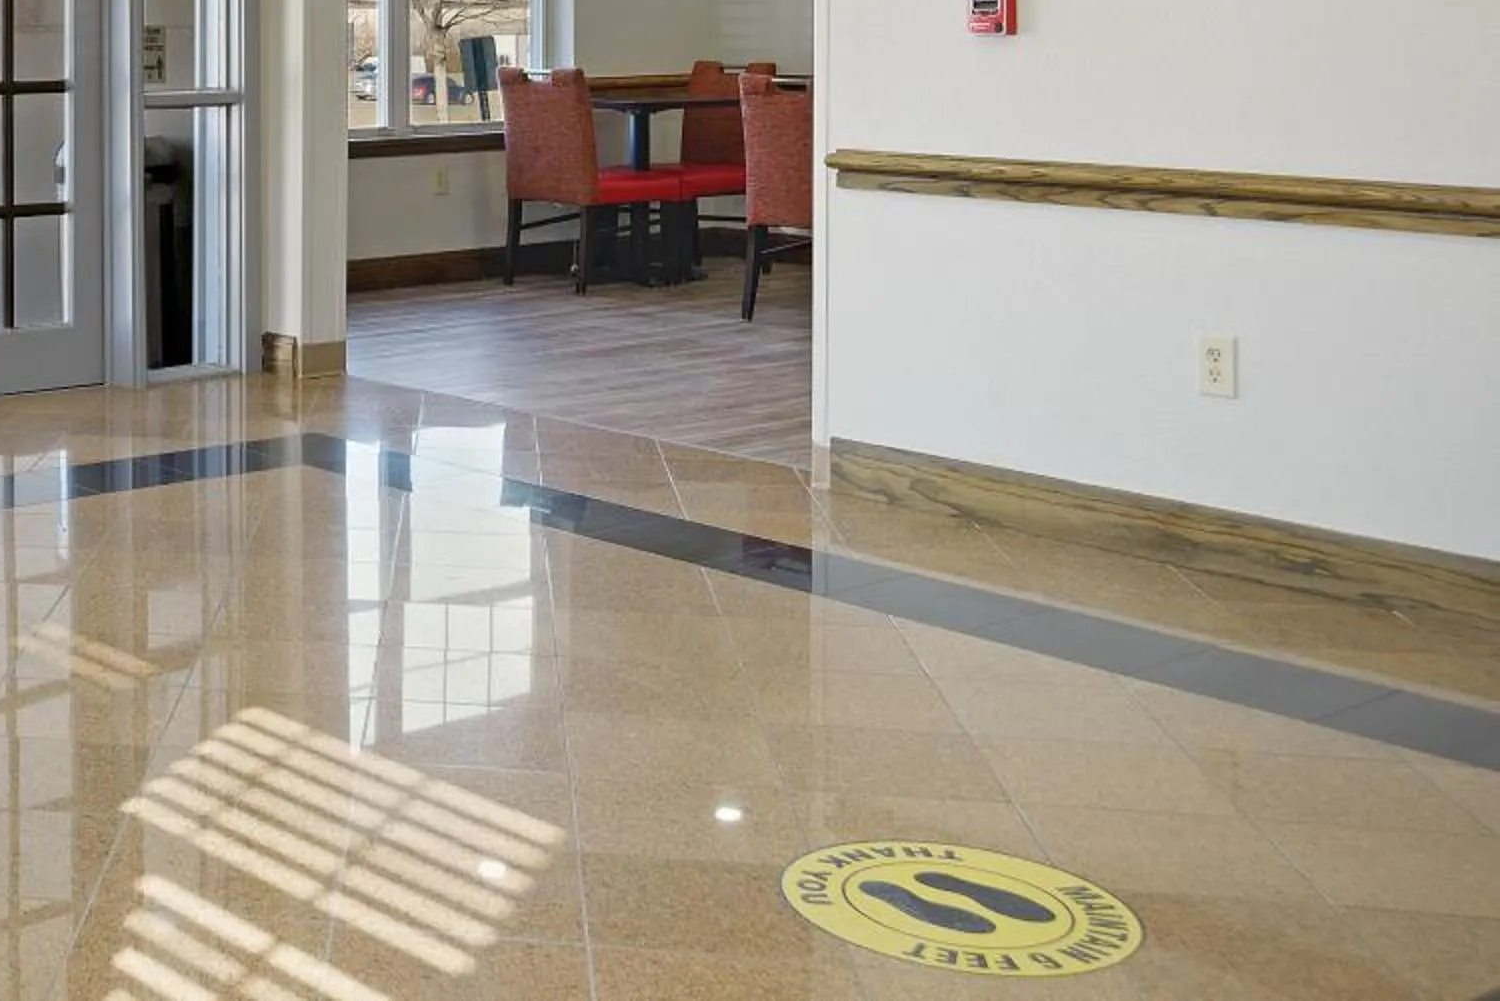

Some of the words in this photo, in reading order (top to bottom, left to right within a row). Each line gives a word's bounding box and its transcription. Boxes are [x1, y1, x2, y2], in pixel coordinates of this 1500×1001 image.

[817, 846, 963, 868] THANK
[797, 871, 833, 904] YOU
[1056, 885, 1129, 964] MAINTAIN
[901, 942, 1021, 971] FEET
[1028, 952, 1063, 970] 6
